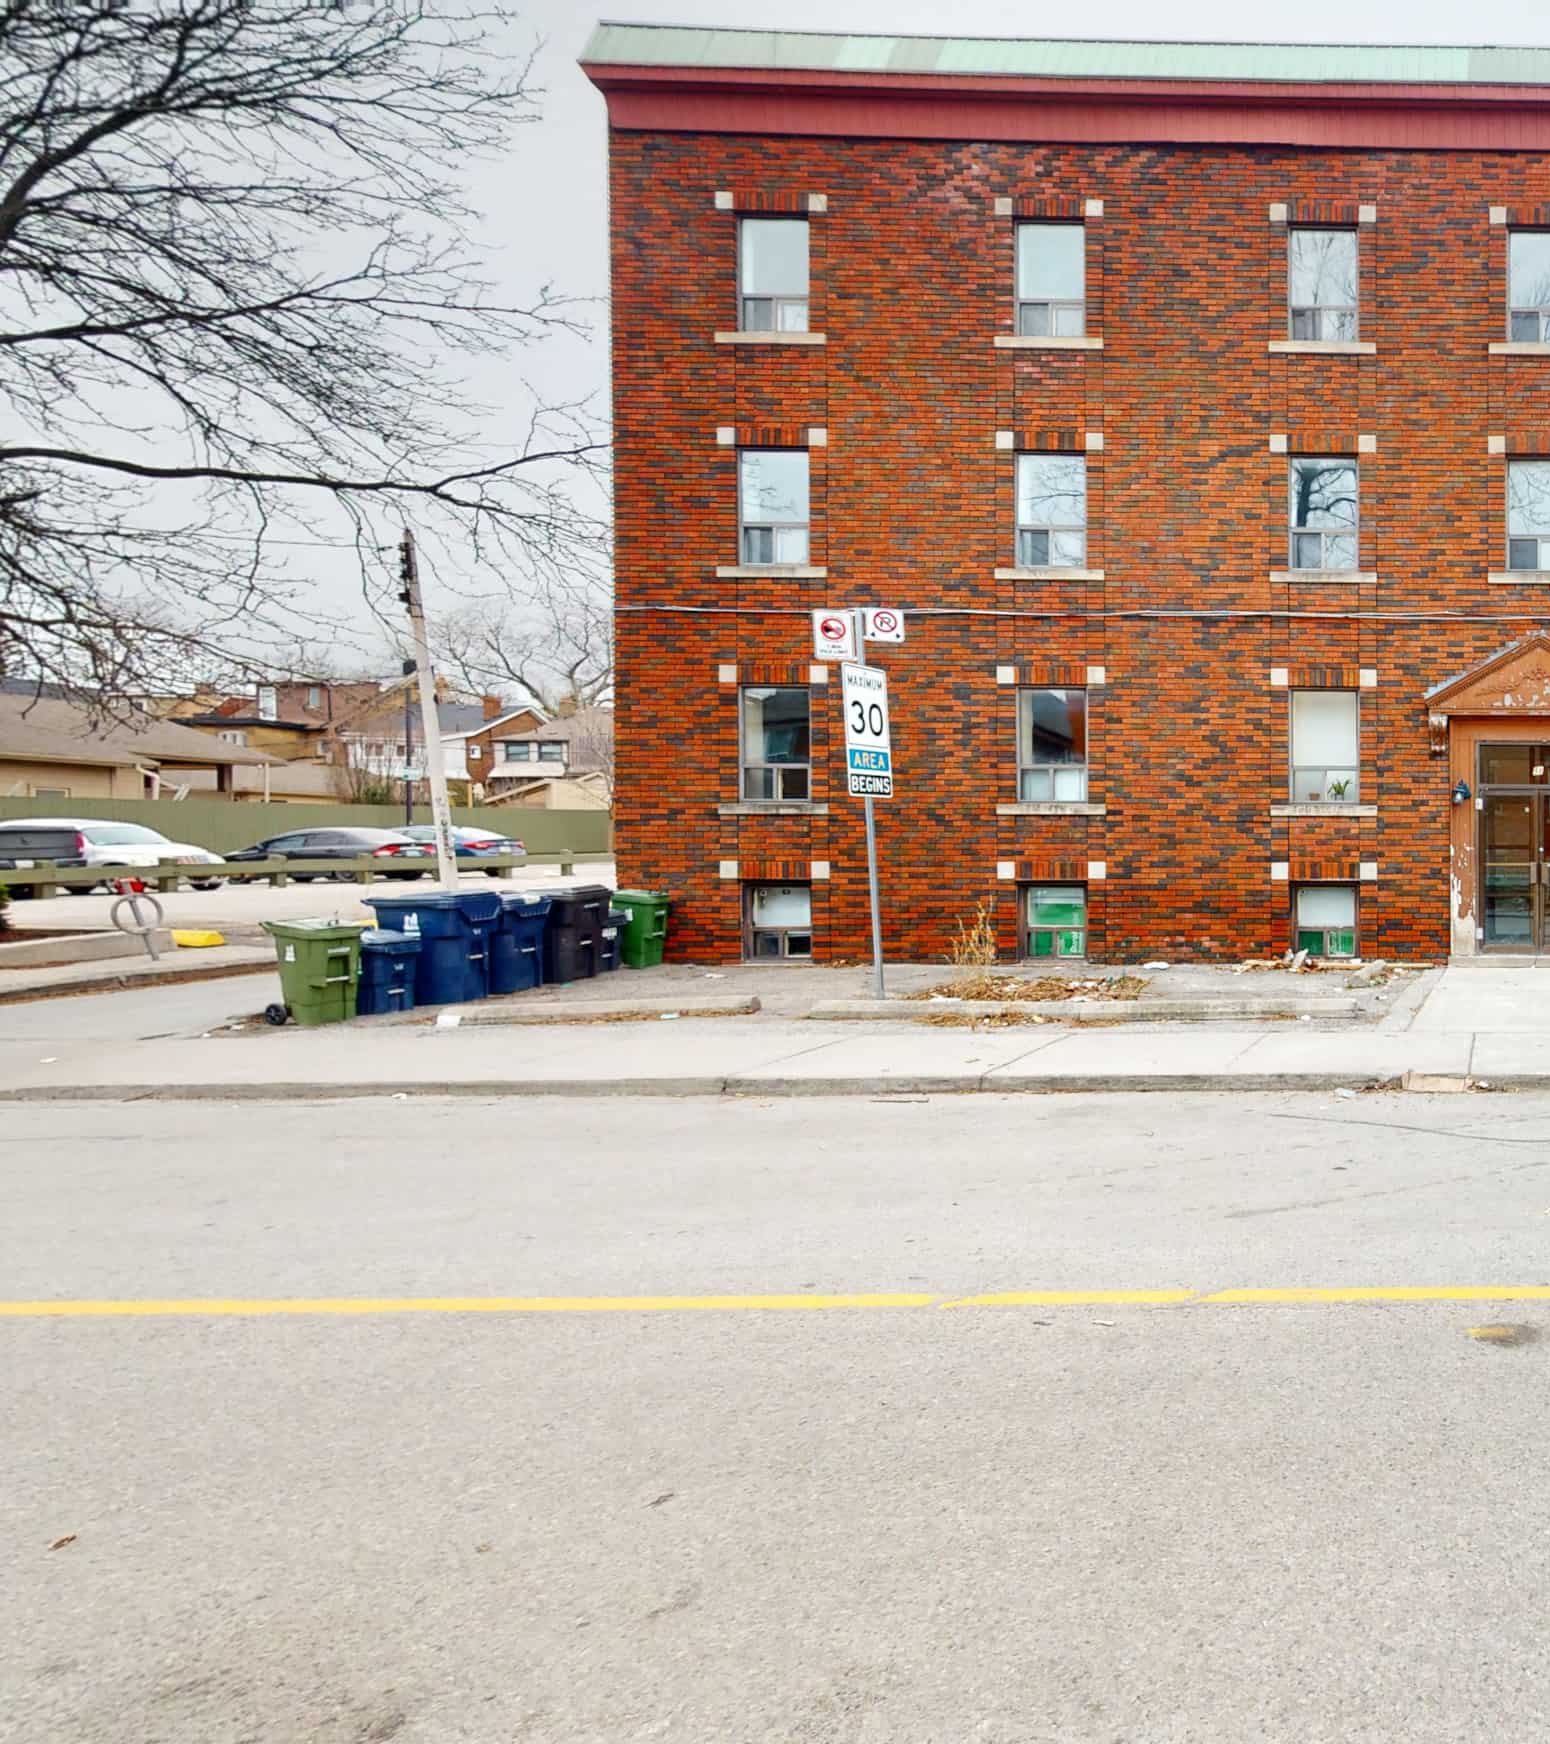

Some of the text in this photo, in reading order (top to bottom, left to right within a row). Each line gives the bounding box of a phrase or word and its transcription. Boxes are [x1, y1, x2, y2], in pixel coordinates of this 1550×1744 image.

[847, 674, 882, 691] MAXIMUM
[851, 700, 883, 736] 30
[854, 752, 886, 769] AREA
[851, 775, 890, 793] BEGINS
